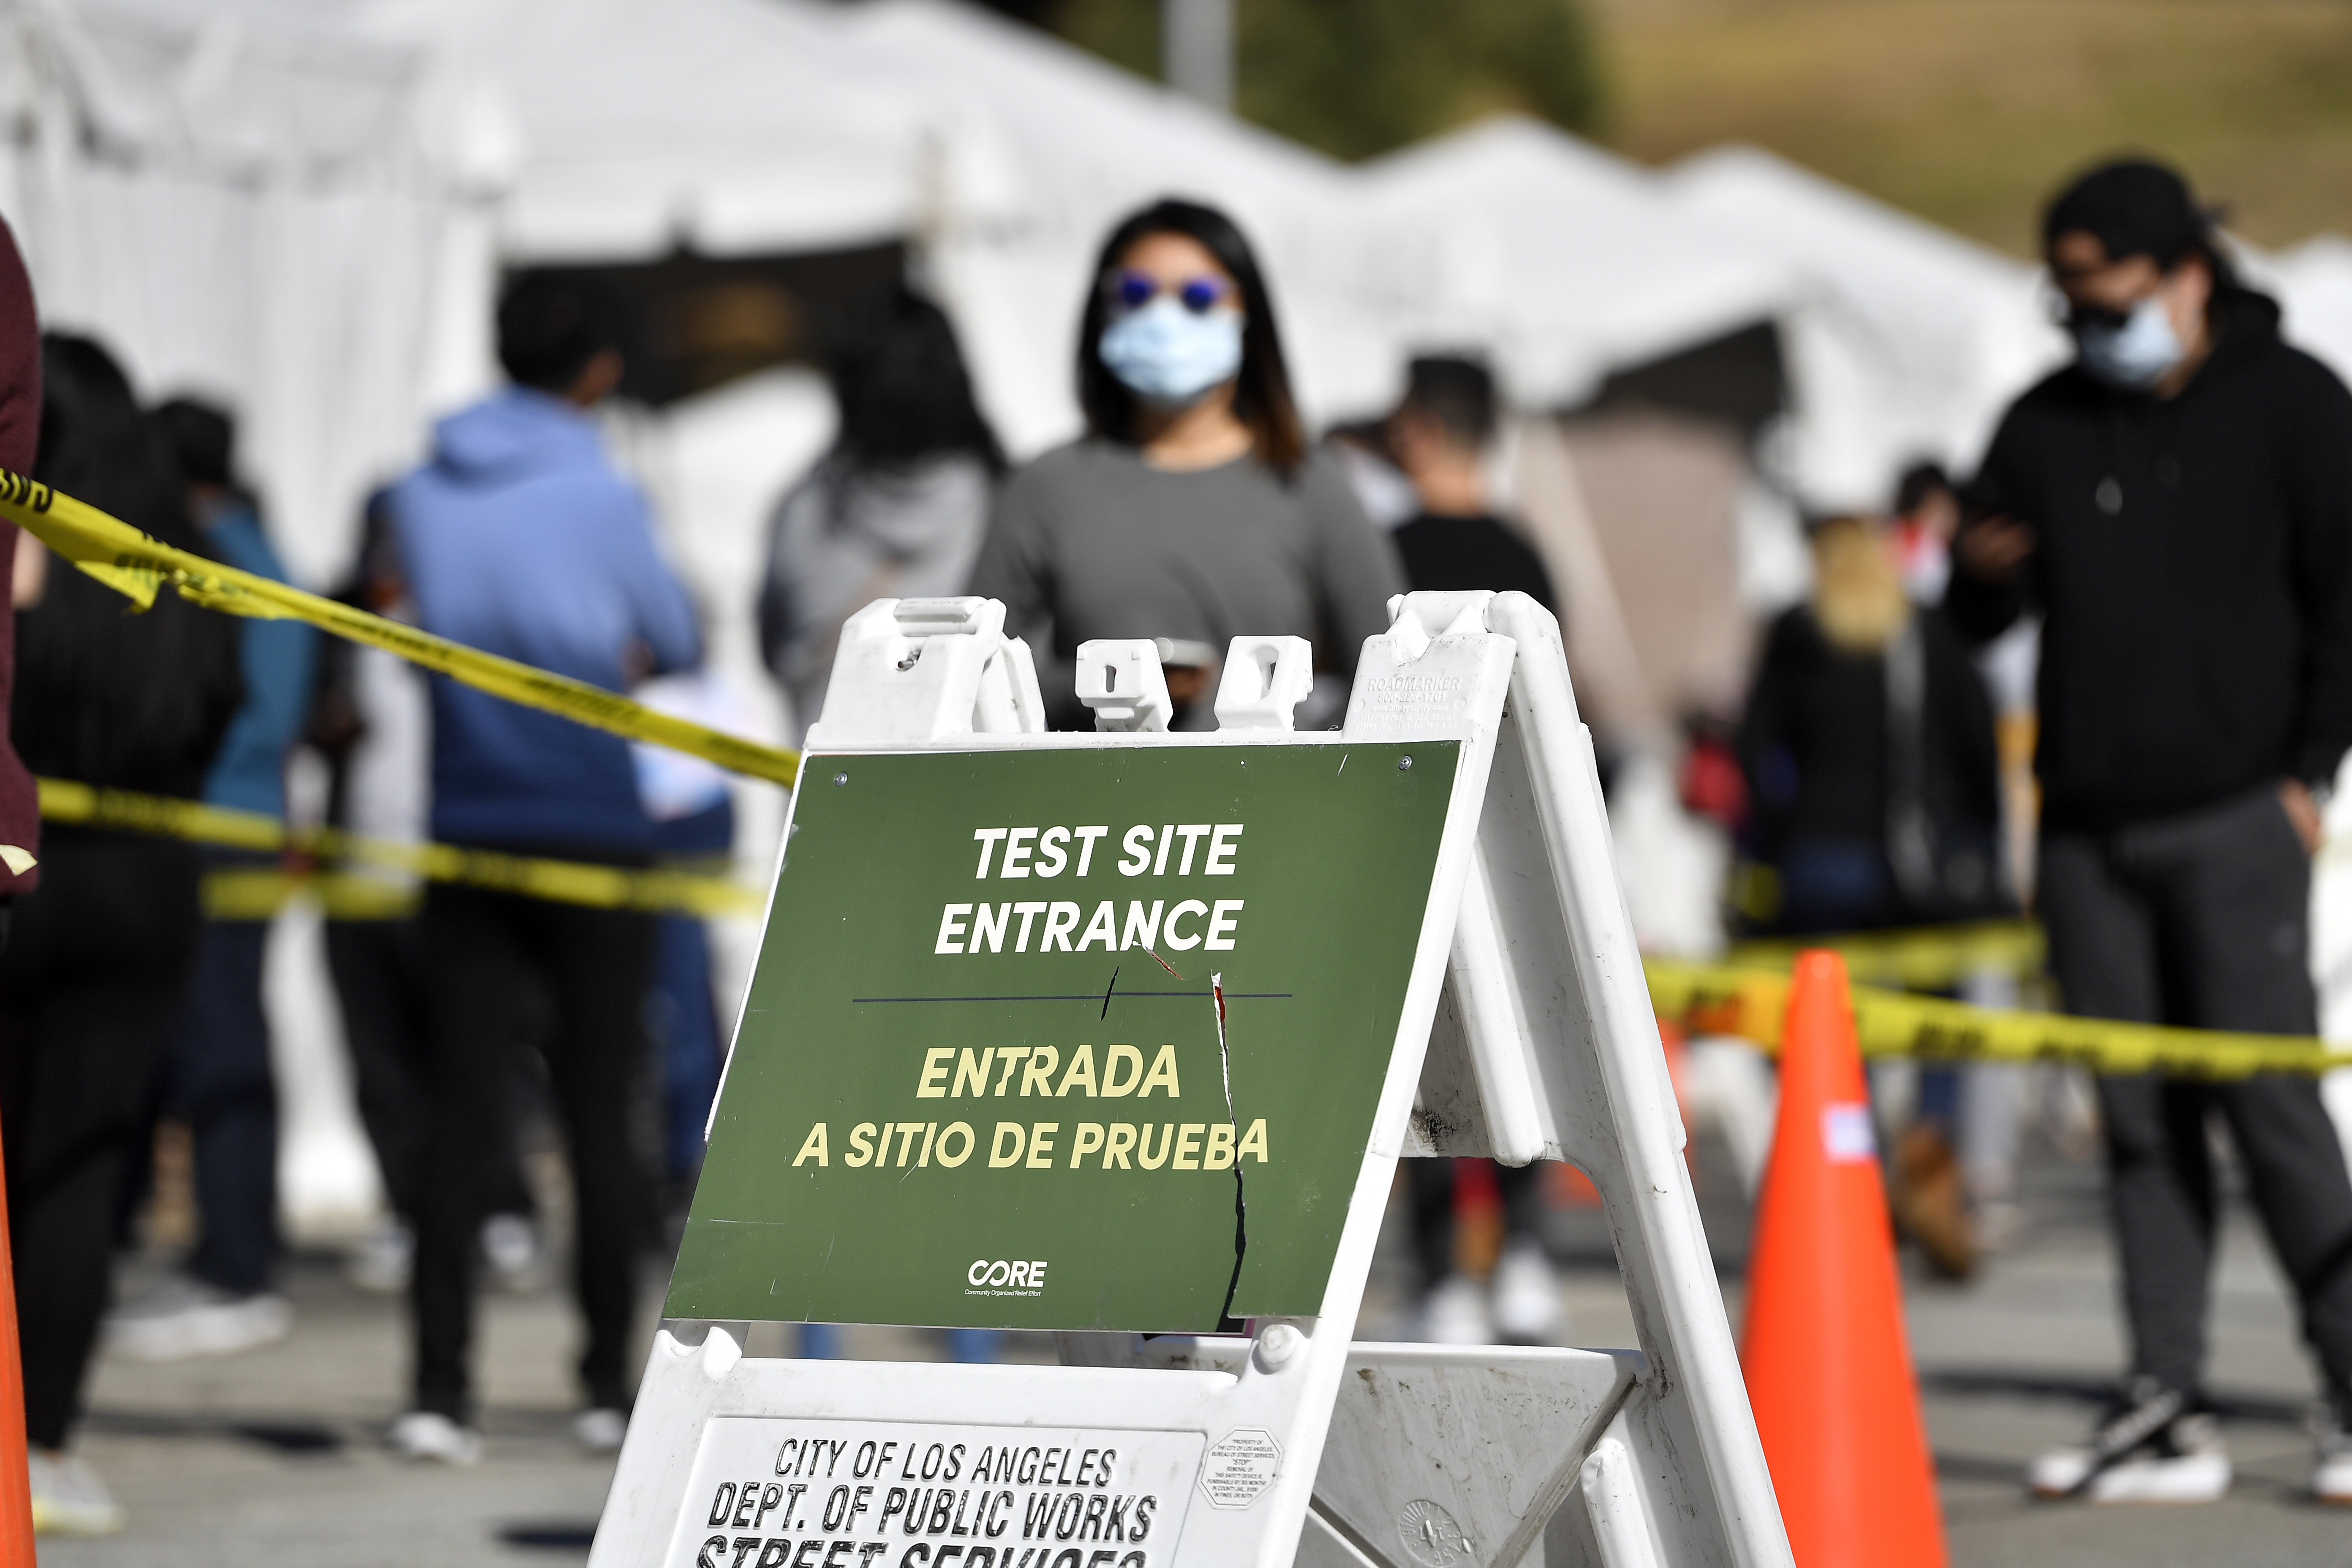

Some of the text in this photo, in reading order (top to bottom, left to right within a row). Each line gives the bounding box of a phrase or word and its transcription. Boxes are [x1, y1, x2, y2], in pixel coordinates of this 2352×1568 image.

[1368, 676, 1462, 691] ROADMARKER
[1377, 691, 1446, 703] 800-228-1701
[974, 824, 1244, 879] TEST SITE
[934, 899, 1244, 954] ENTRANCE
[916, 1045, 1180, 1097] ENTRADA
[792, 1119, 1268, 1170] A SITIO DE PRUEBA
[968, 1260, 1047, 1287] CORE
[776, 1438, 1116, 1487] CITY OF LOS ANGELES
[708, 1481, 1157, 1541] DEPT. OF PUBLIC WORKS
